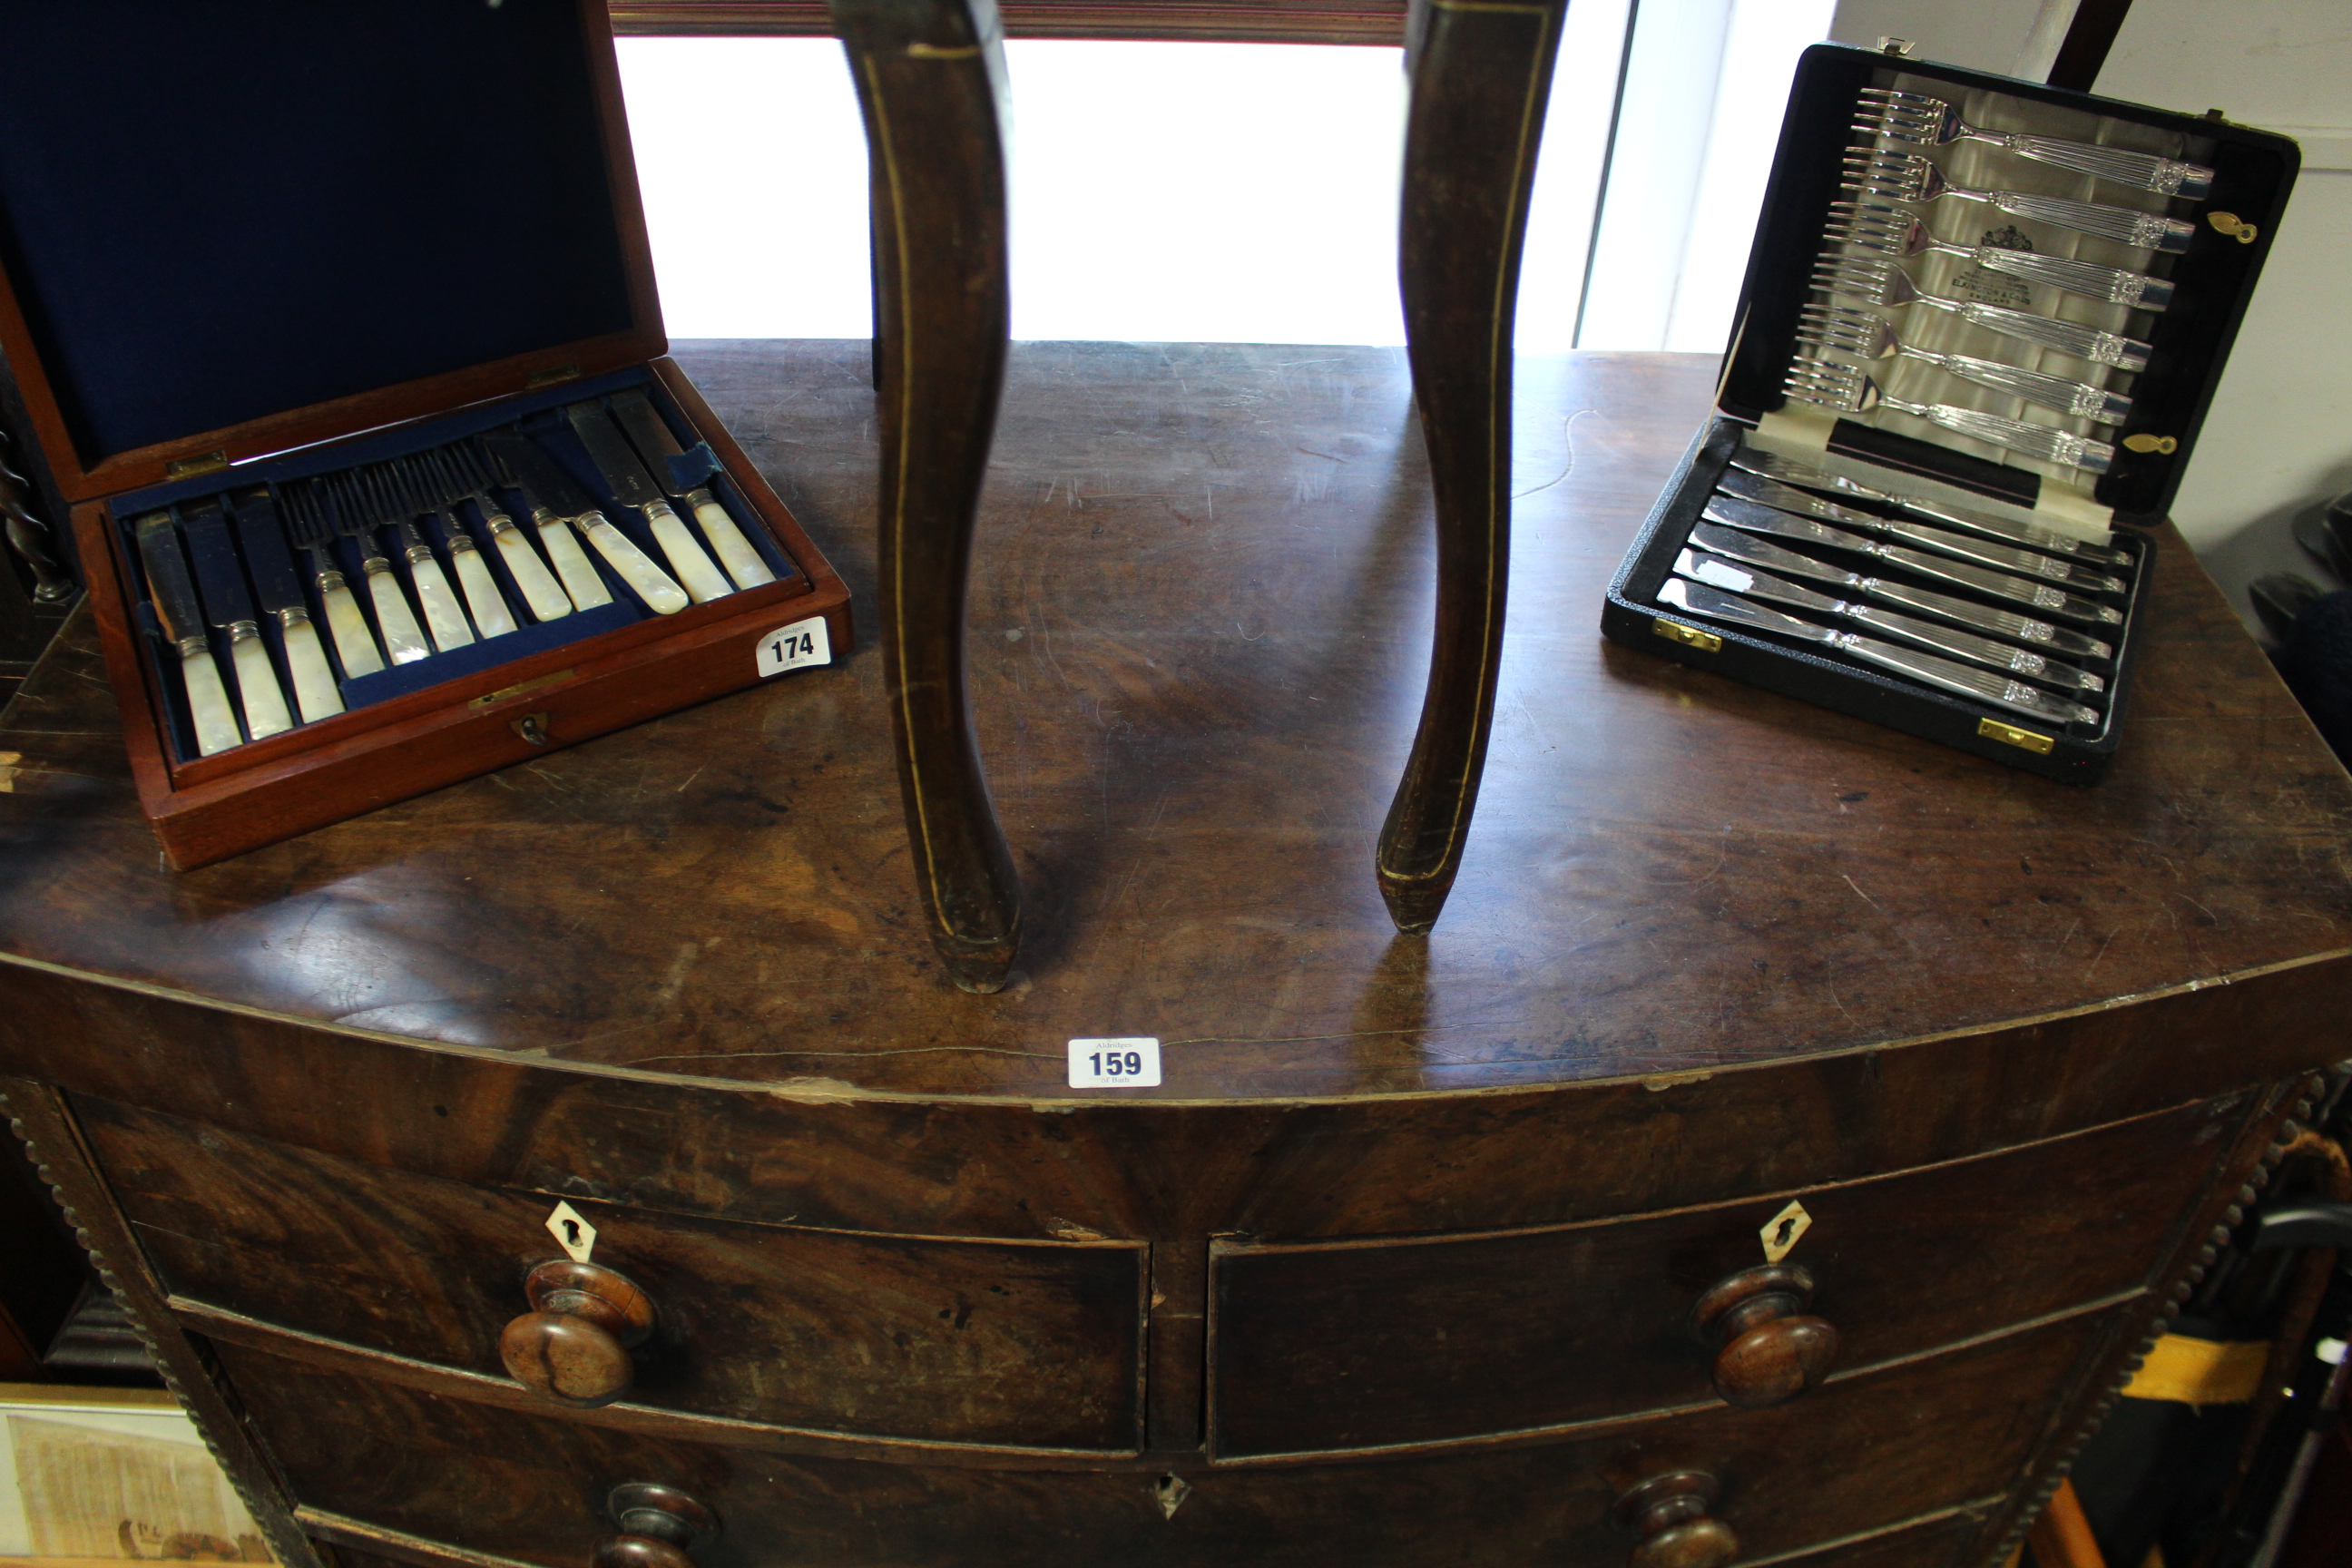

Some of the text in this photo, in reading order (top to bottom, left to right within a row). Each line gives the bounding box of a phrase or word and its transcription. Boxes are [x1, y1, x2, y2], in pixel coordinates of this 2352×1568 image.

[776, 626, 805, 637] Aldridges
[771, 632, 814, 662] 174
[1089, 1052, 1142, 1076] 159
